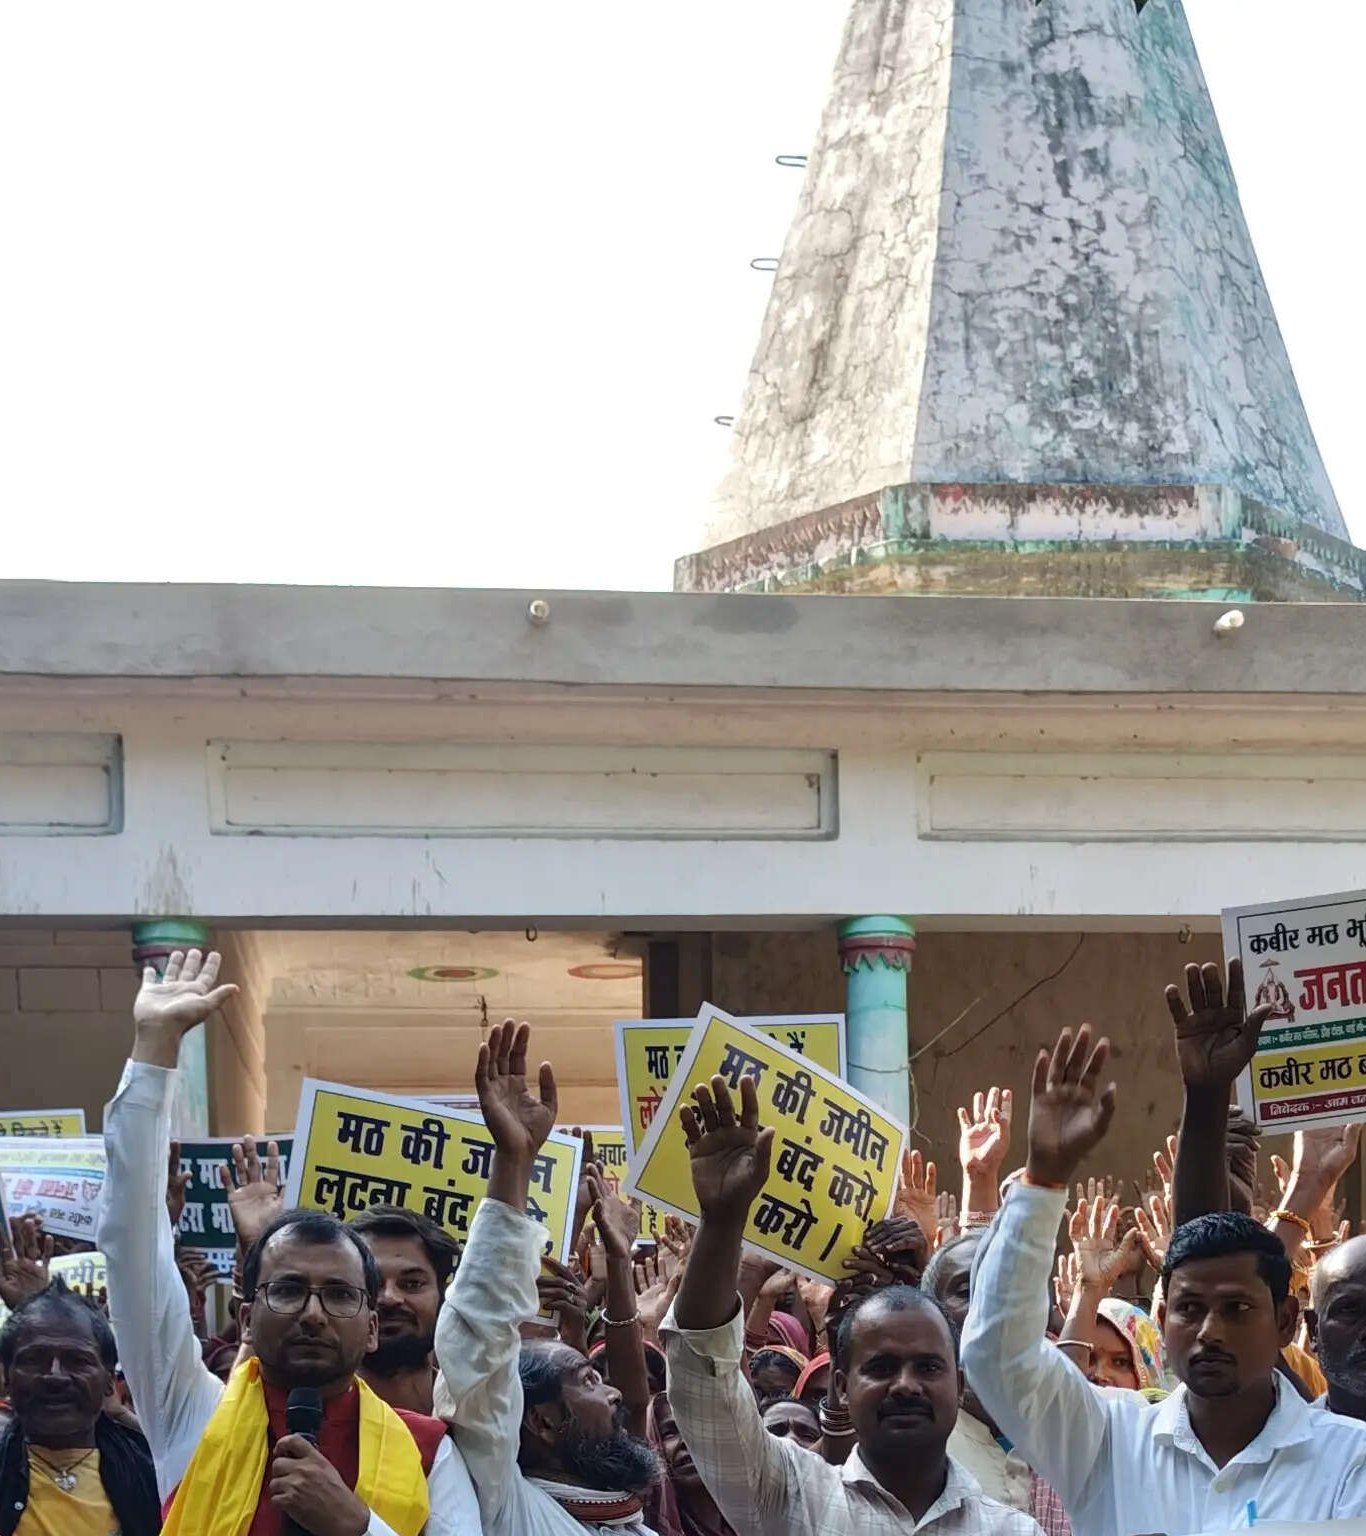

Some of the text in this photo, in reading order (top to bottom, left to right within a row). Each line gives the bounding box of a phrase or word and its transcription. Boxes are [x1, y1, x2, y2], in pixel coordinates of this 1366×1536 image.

[1248, 923, 1299, 954] कबीर
[1306, 924, 1339, 946] मठ
[1259, 1057, 1315, 1089] कबीर
[1319, 1056, 1353, 1080] मठ
[336, 1111, 451, 1170] मठ की
[772, 1070, 817, 1125] की
[819, 1097, 890, 1172] जमीन
[776, 1136, 825, 1192] बंद
[423, 1178, 474, 1232] बंद
[752, 1193, 818, 1250] करो
